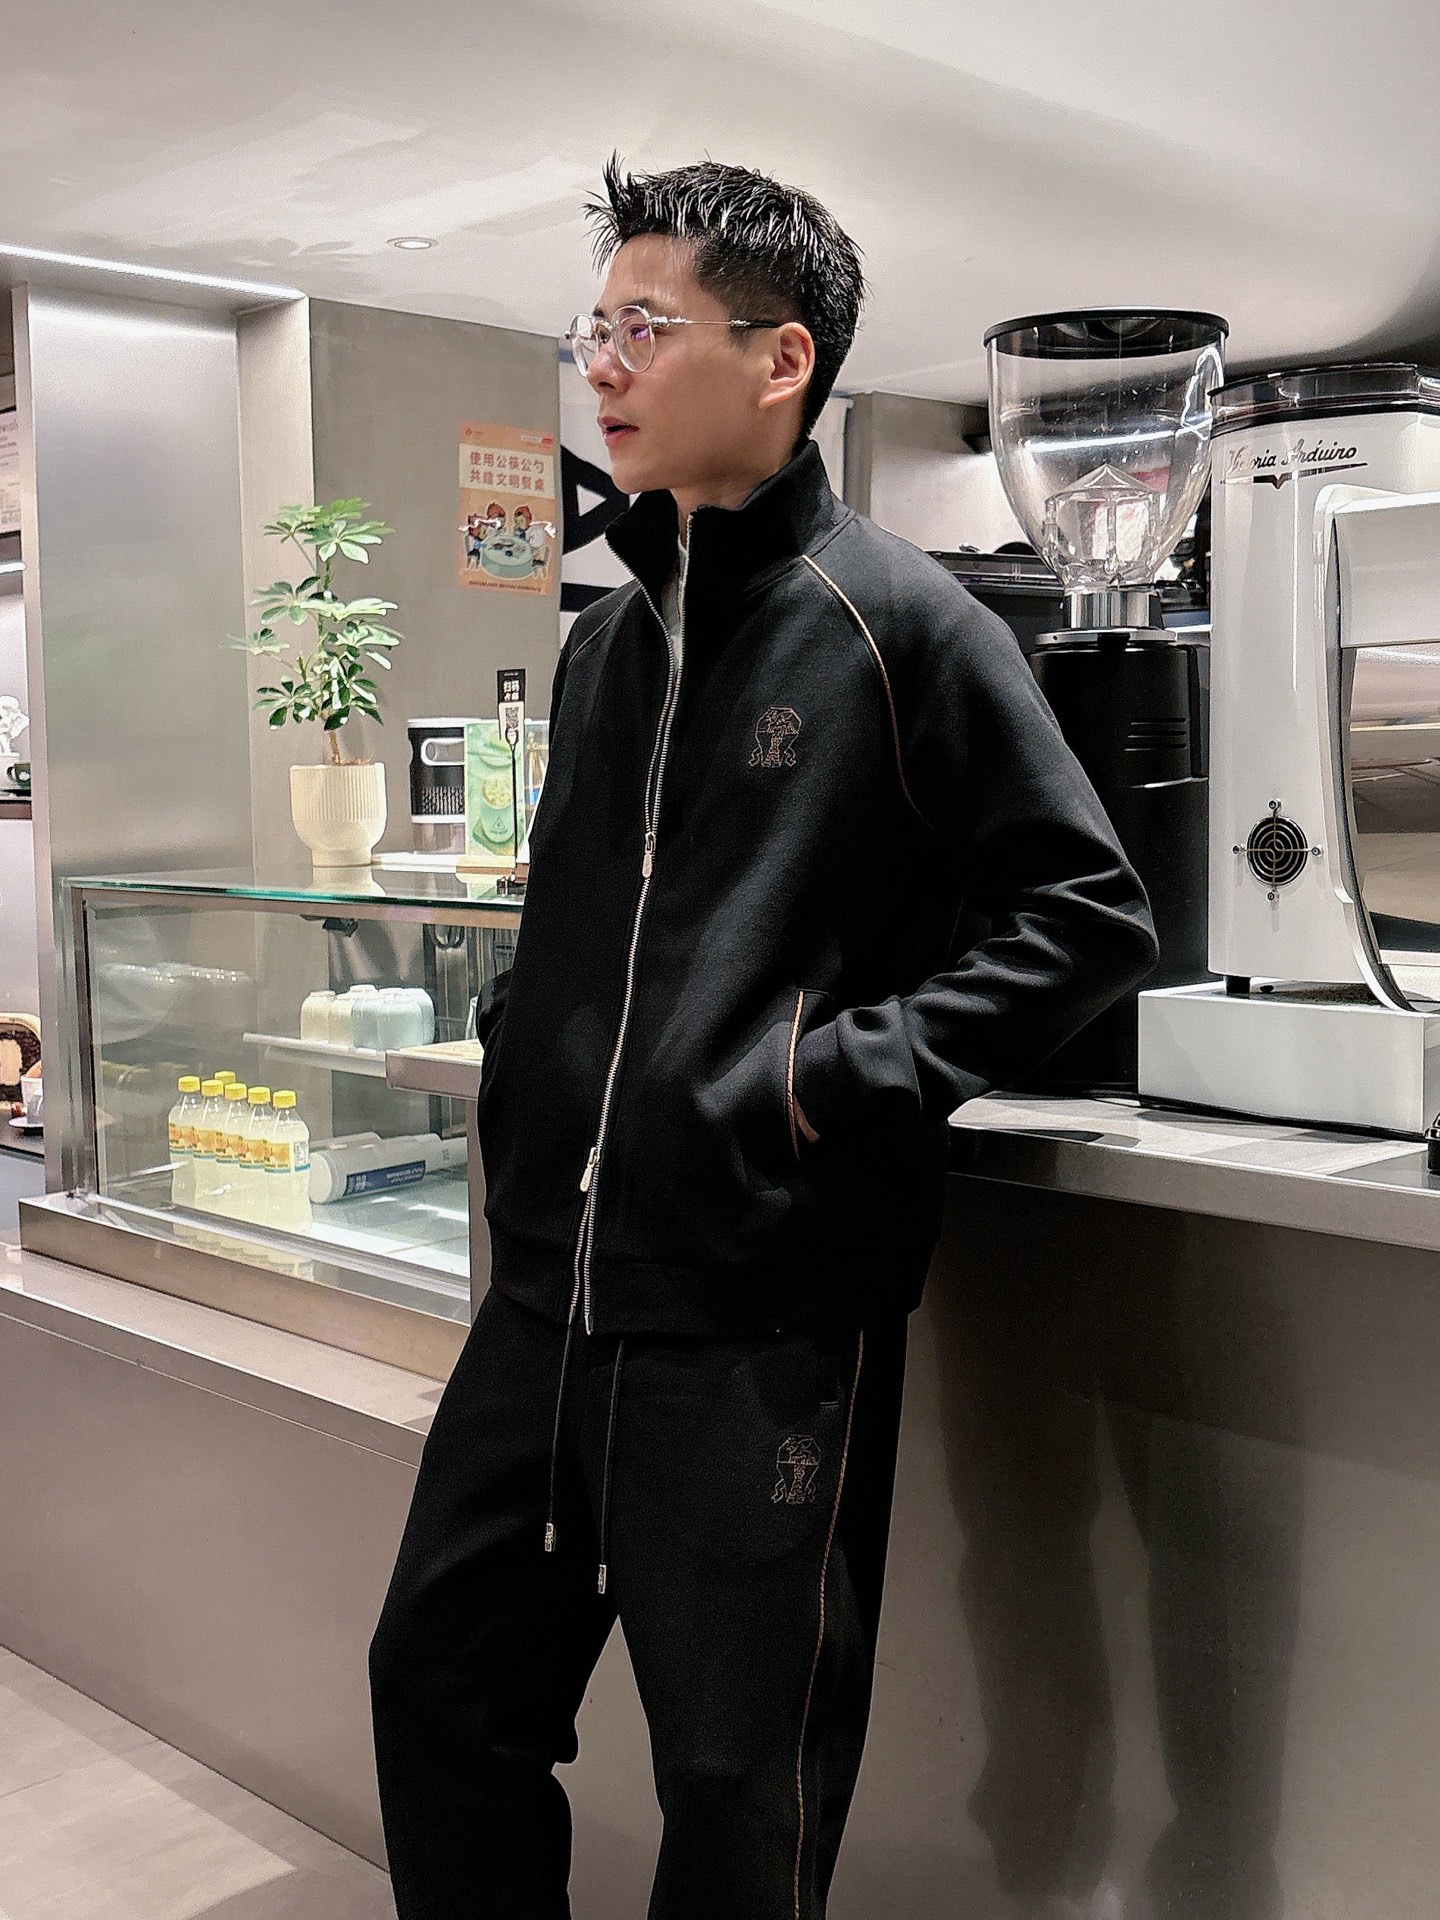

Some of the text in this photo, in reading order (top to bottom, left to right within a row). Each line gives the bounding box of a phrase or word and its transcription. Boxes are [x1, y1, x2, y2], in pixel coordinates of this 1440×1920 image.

[470, 450, 545, 475] 使用公筷公勺
[470, 469, 545, 493] 共建文明餐桌
